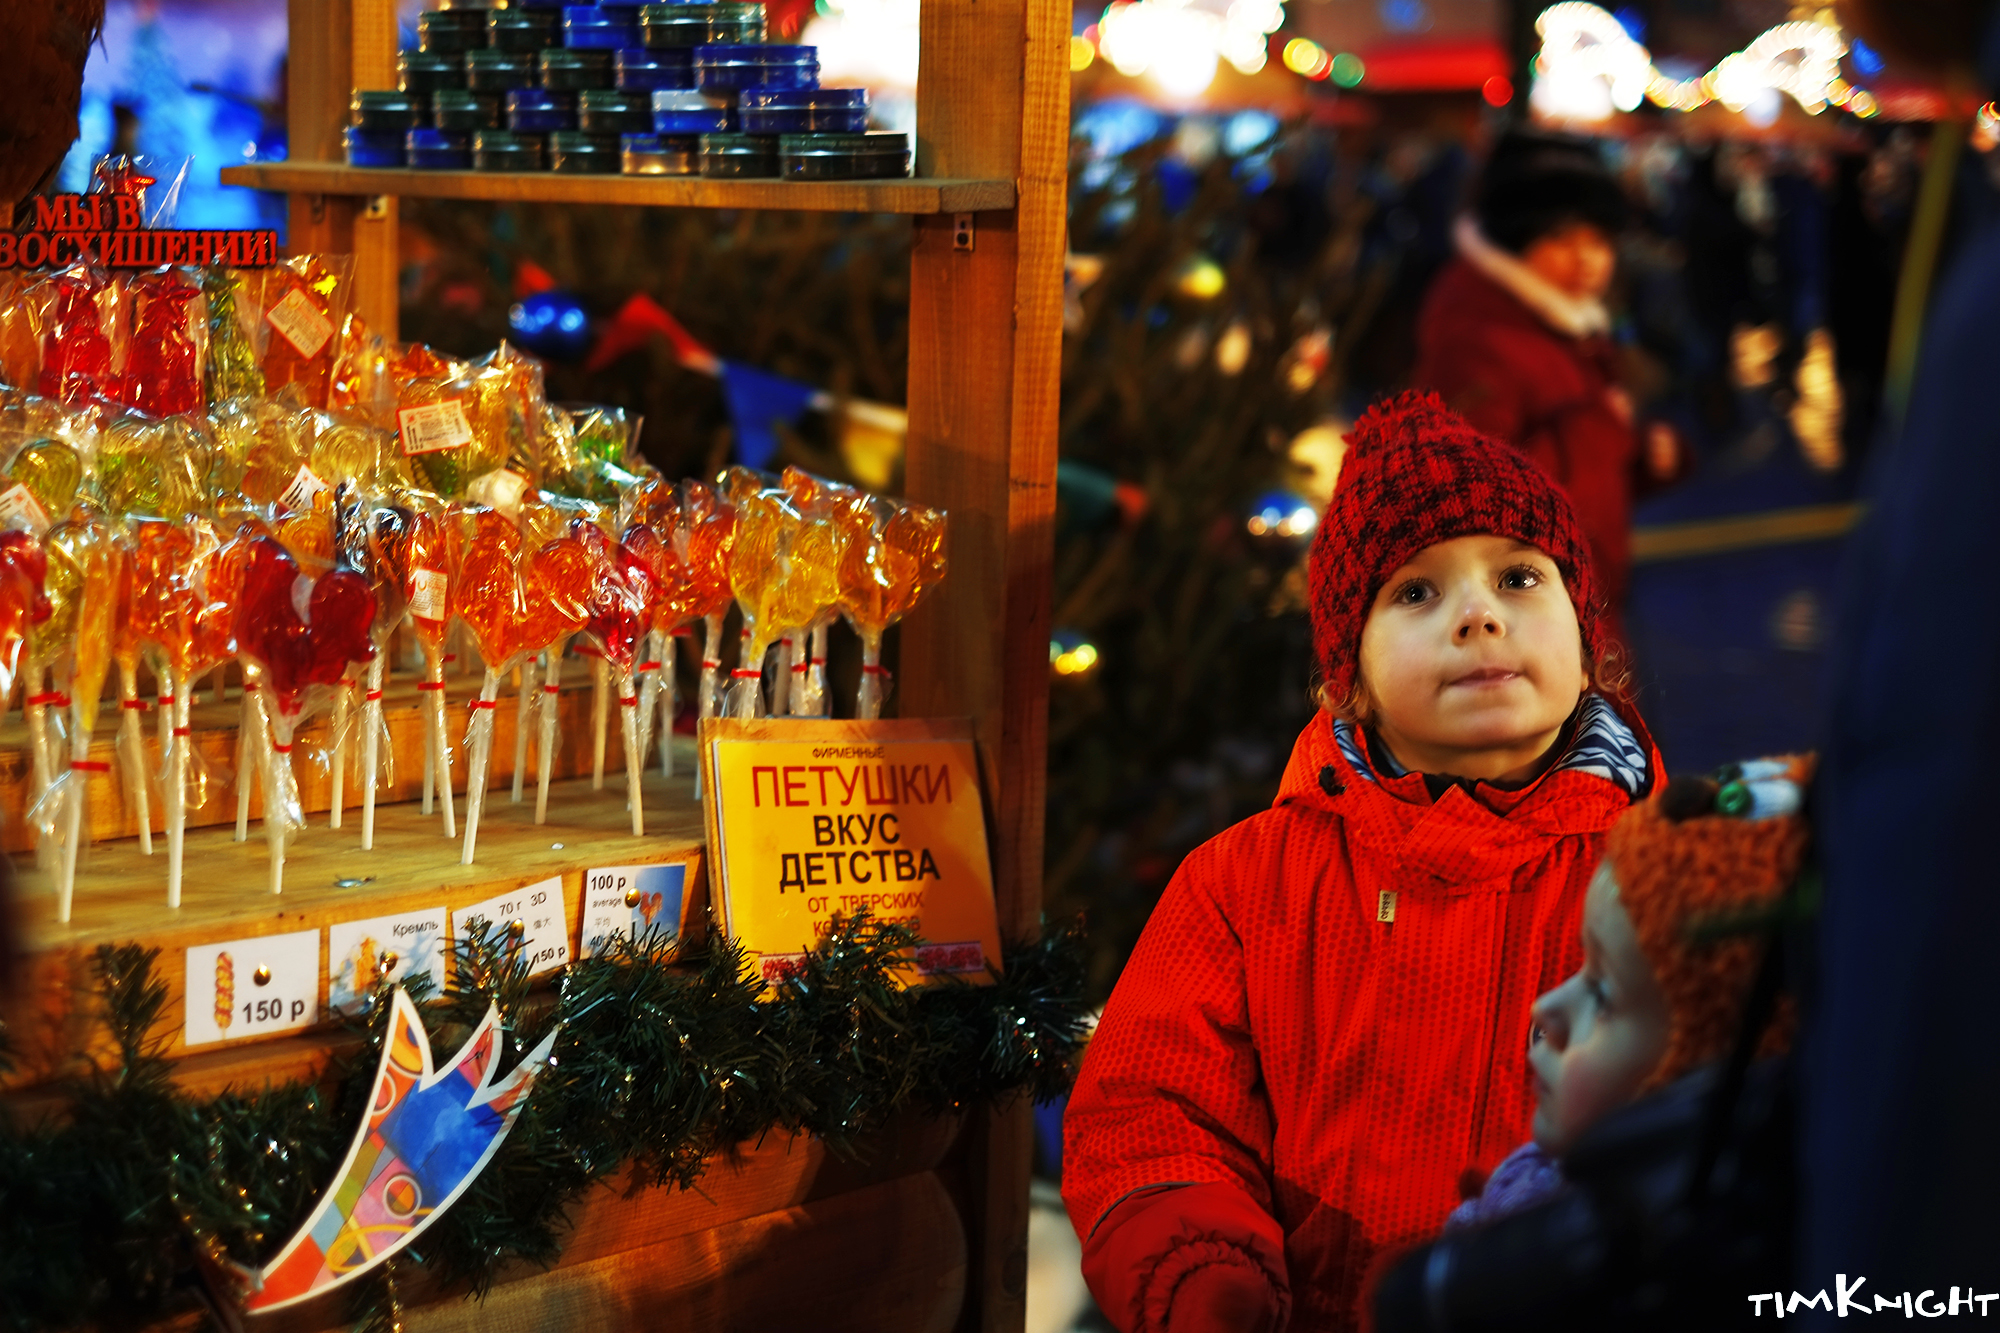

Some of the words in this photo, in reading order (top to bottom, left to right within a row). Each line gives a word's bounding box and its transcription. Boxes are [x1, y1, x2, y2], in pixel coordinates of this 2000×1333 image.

[33, 195, 103, 231] МЫ
[113, 195, 140, 231] В
[812, 747, 885, 759] ФИРМЕННЫЕ
[752, 764, 952, 808] ПЕТУШКИ
[813, 813, 900, 847] ВКУС
[591, 874, 614, 891] 100
[779, 848, 940, 894] ДЕТСТВА
[499, 902, 514, 917] 70
[530, 891, 547, 907] 3D
[592, 897, 622, 908] average
[808, 896, 829, 914] ОТ
[839, 890, 924, 912] ТВЕРСКИХ
[393, 921, 439, 938] Кремль
[536, 946, 554, 963] 150
[243, 998, 282, 1024] 150
